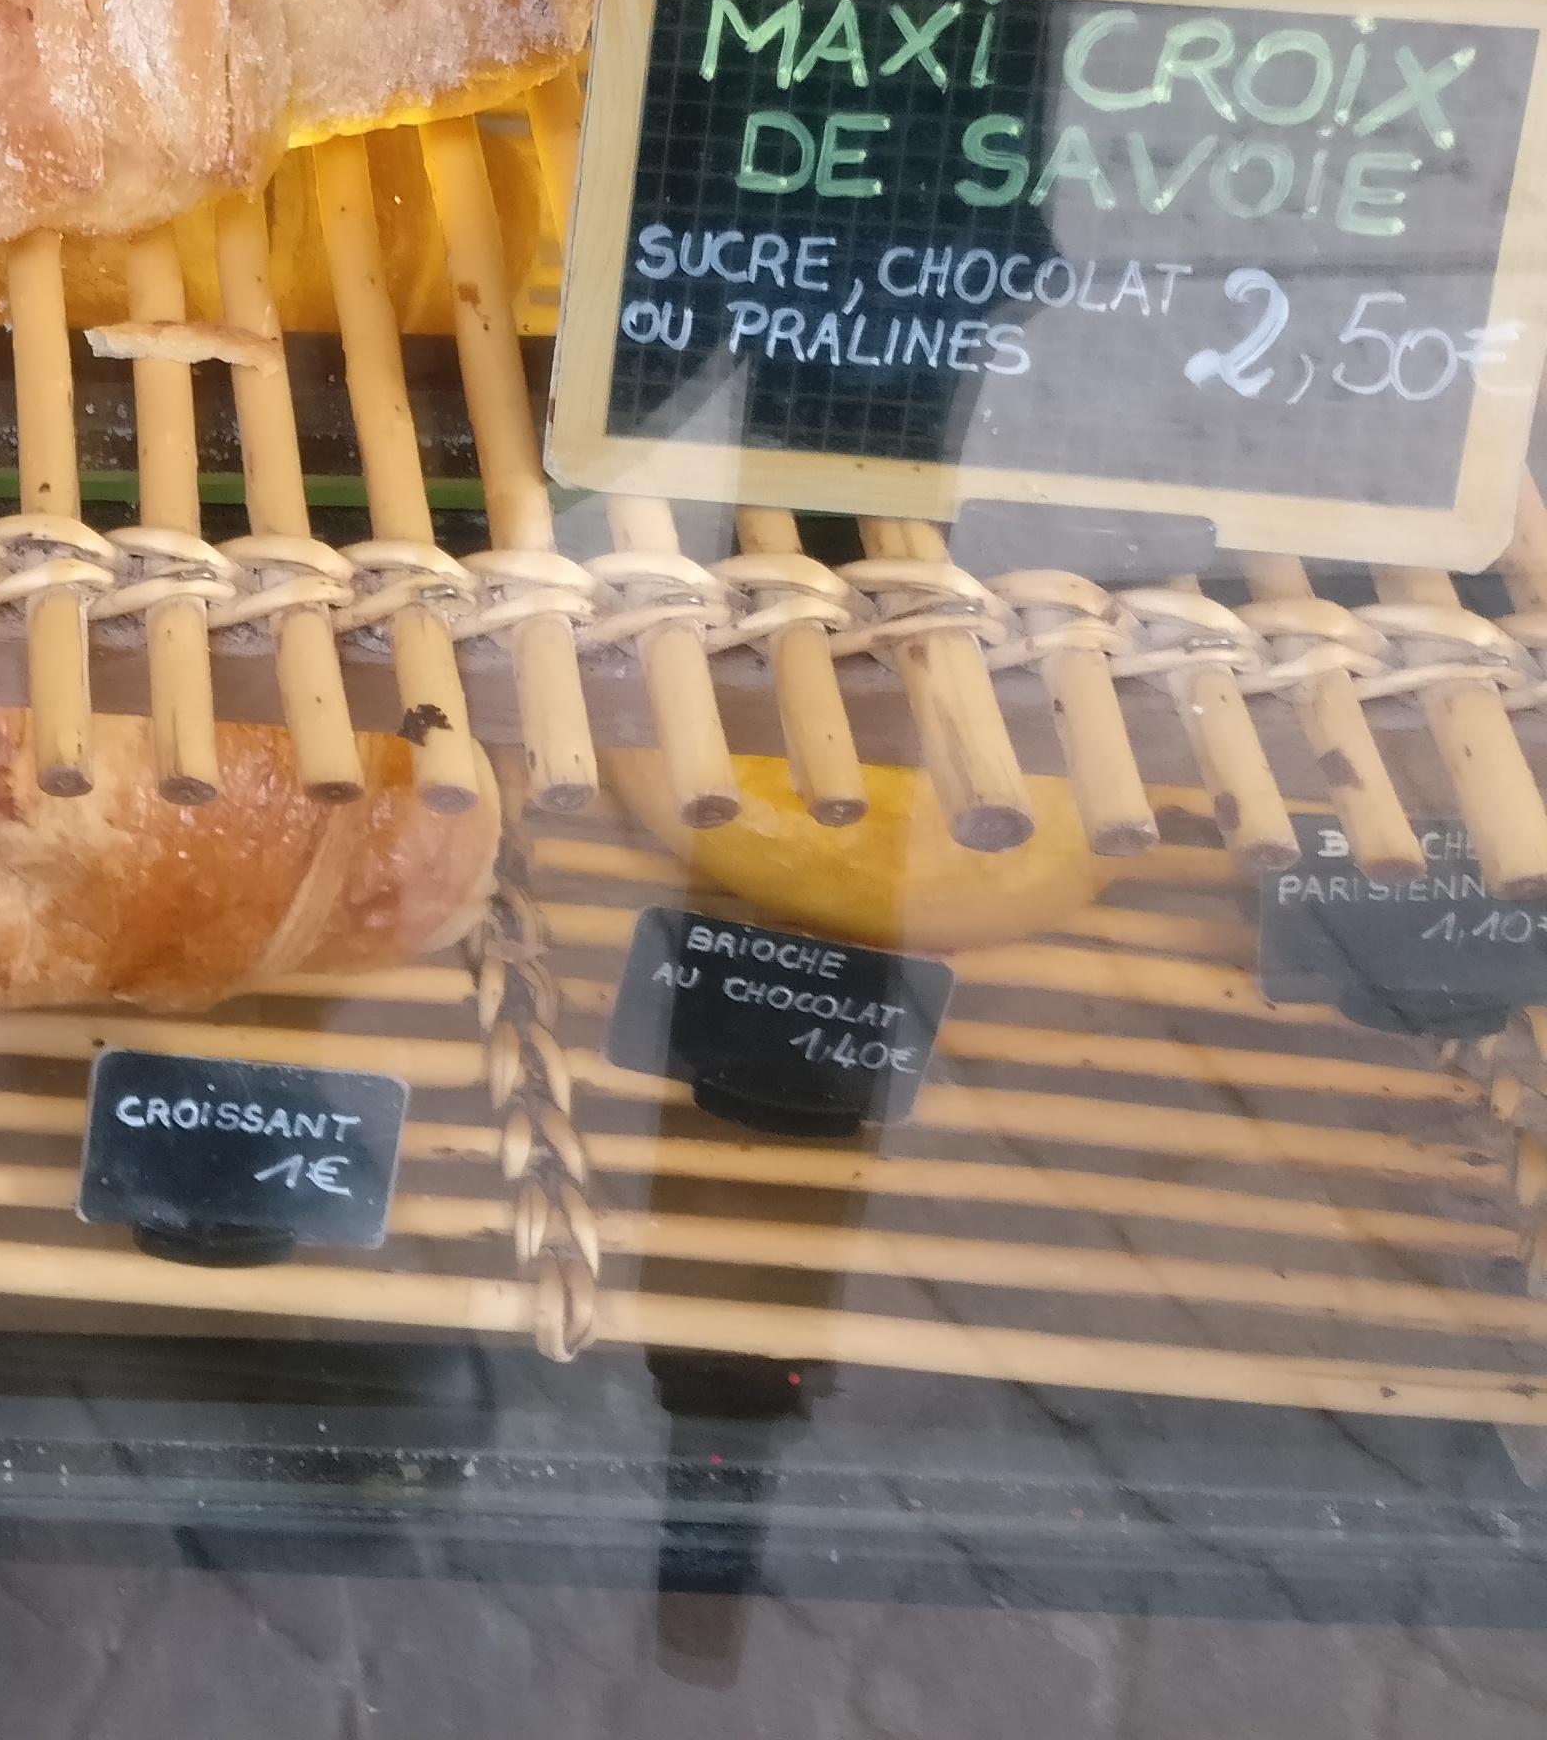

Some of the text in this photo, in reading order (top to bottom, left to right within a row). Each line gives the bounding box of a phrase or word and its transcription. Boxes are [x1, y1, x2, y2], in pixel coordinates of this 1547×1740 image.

[736, 111, 891, 197] DE
[877, 246, 1193, 317] CHOCOLAT
[621, 298, 1032, 376] OU PRALINES
[1184, 266, 1533, 406] 2,50€
[1278, 874, 1489, 905] PARISIENN
[652, 962, 906, 1028] AU CHOCOLAT
[254, 1154, 352, 1198] 1€
